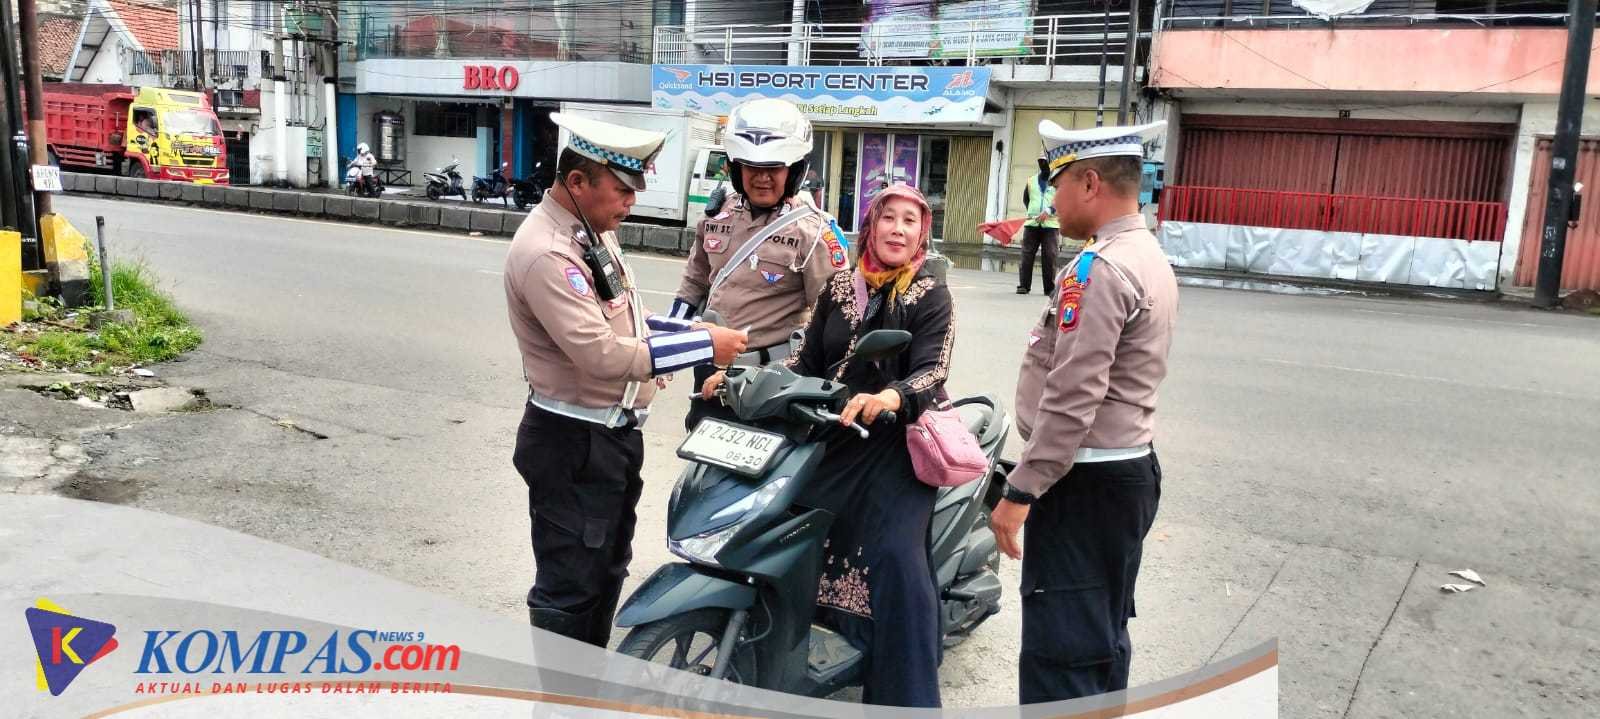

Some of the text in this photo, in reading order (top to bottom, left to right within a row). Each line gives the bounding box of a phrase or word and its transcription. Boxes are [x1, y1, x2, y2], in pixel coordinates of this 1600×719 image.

[463, 66, 519, 91] BRO
[698, 72, 929, 90] HSI SPORT CENTER
[710, 426, 746, 445] 2432
